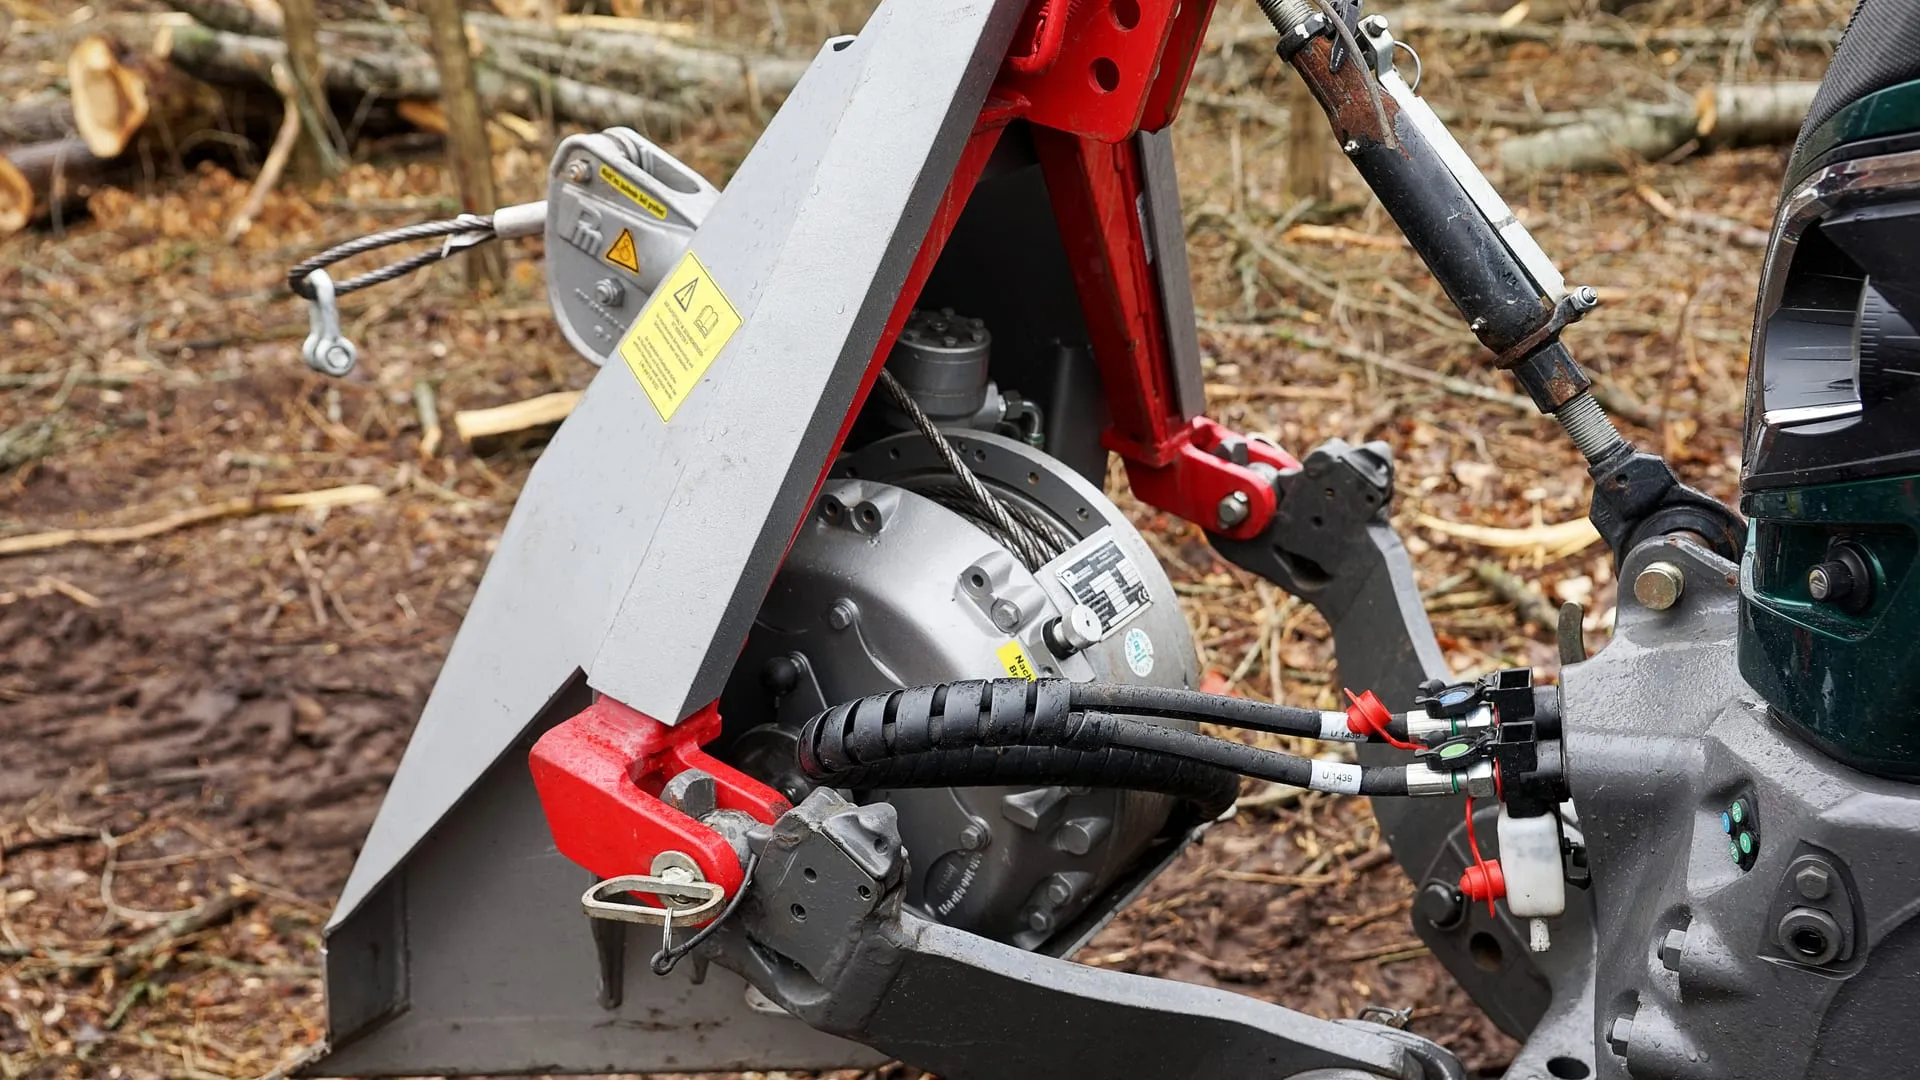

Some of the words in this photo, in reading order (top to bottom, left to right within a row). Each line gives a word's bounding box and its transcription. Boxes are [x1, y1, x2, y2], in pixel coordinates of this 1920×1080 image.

[1015, 654, 1035, 683] Nach
[1322, 771, 1330, 780] U
[1332, 772, 1353, 783] 1439
